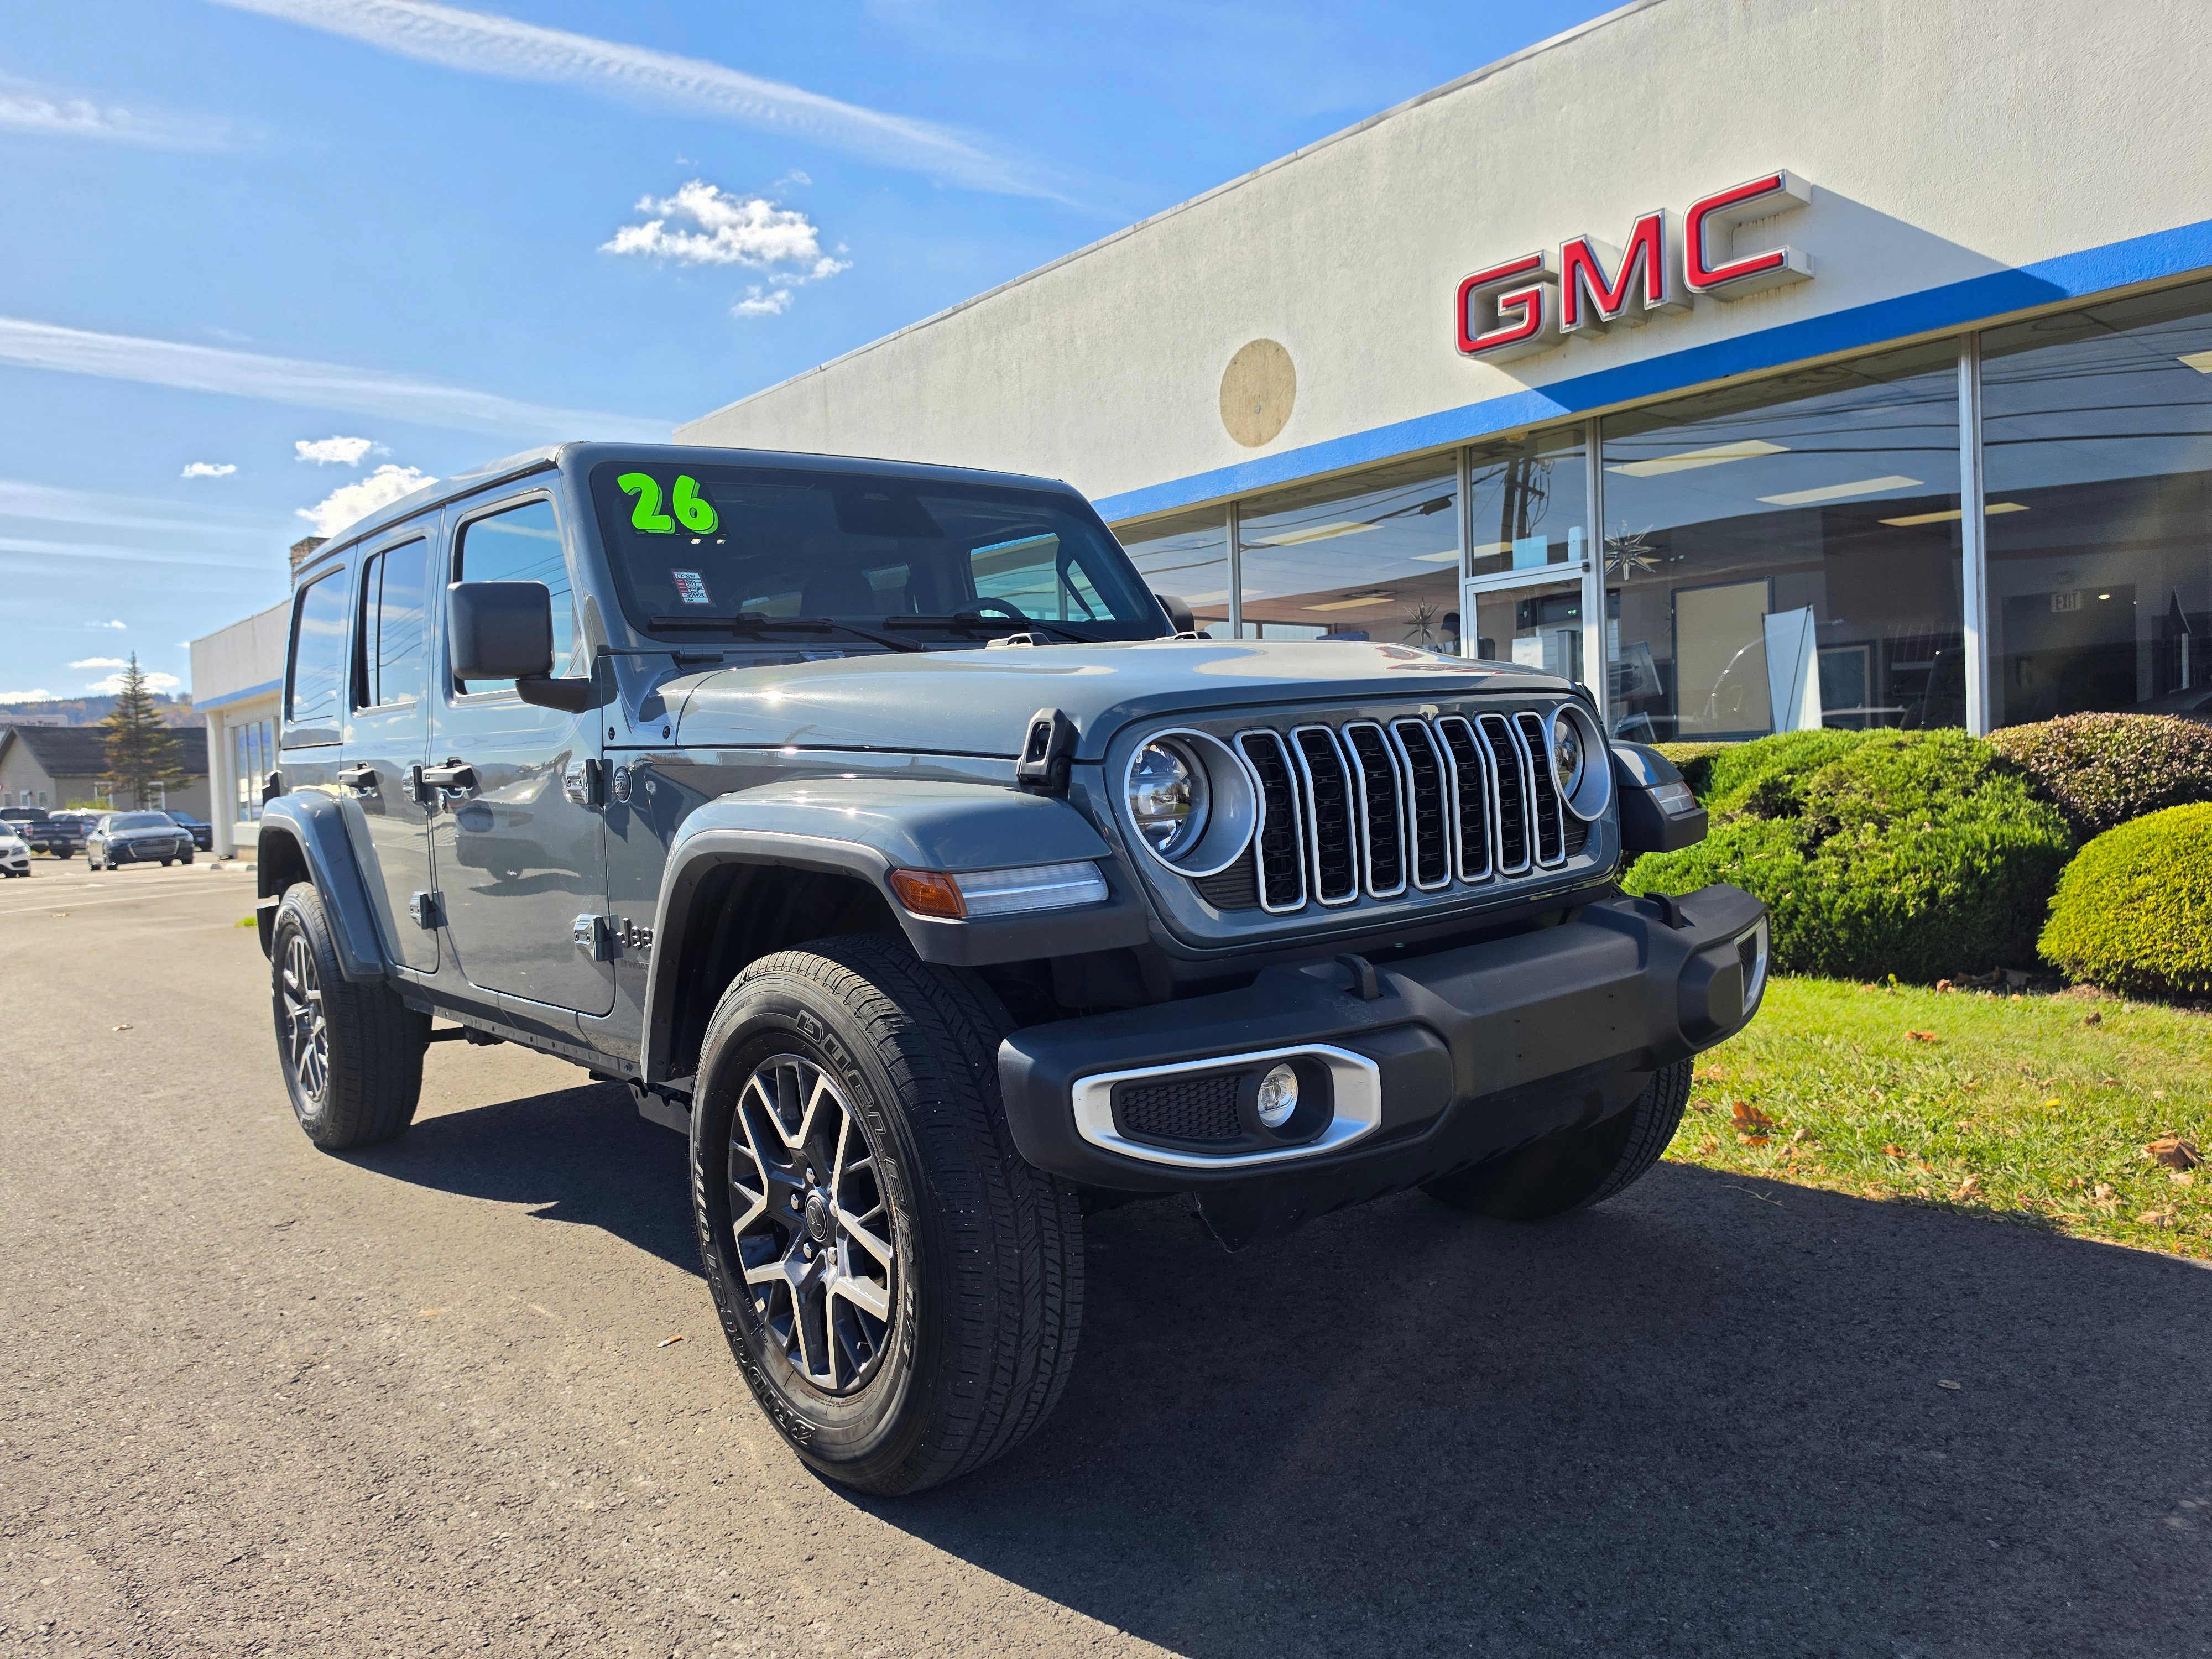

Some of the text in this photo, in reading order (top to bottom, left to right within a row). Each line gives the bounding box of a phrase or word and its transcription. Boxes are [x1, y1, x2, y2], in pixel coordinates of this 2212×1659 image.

[1454, 169, 1800, 359] GMC
[617, 473, 719, 534] 26
[2056, 593, 2078, 610] EXIT
[617, 917, 653, 951] Jee
[796, 1009, 916, 1266] DUELER
[693, 1140, 815, 1447] BRIDGESTONE
